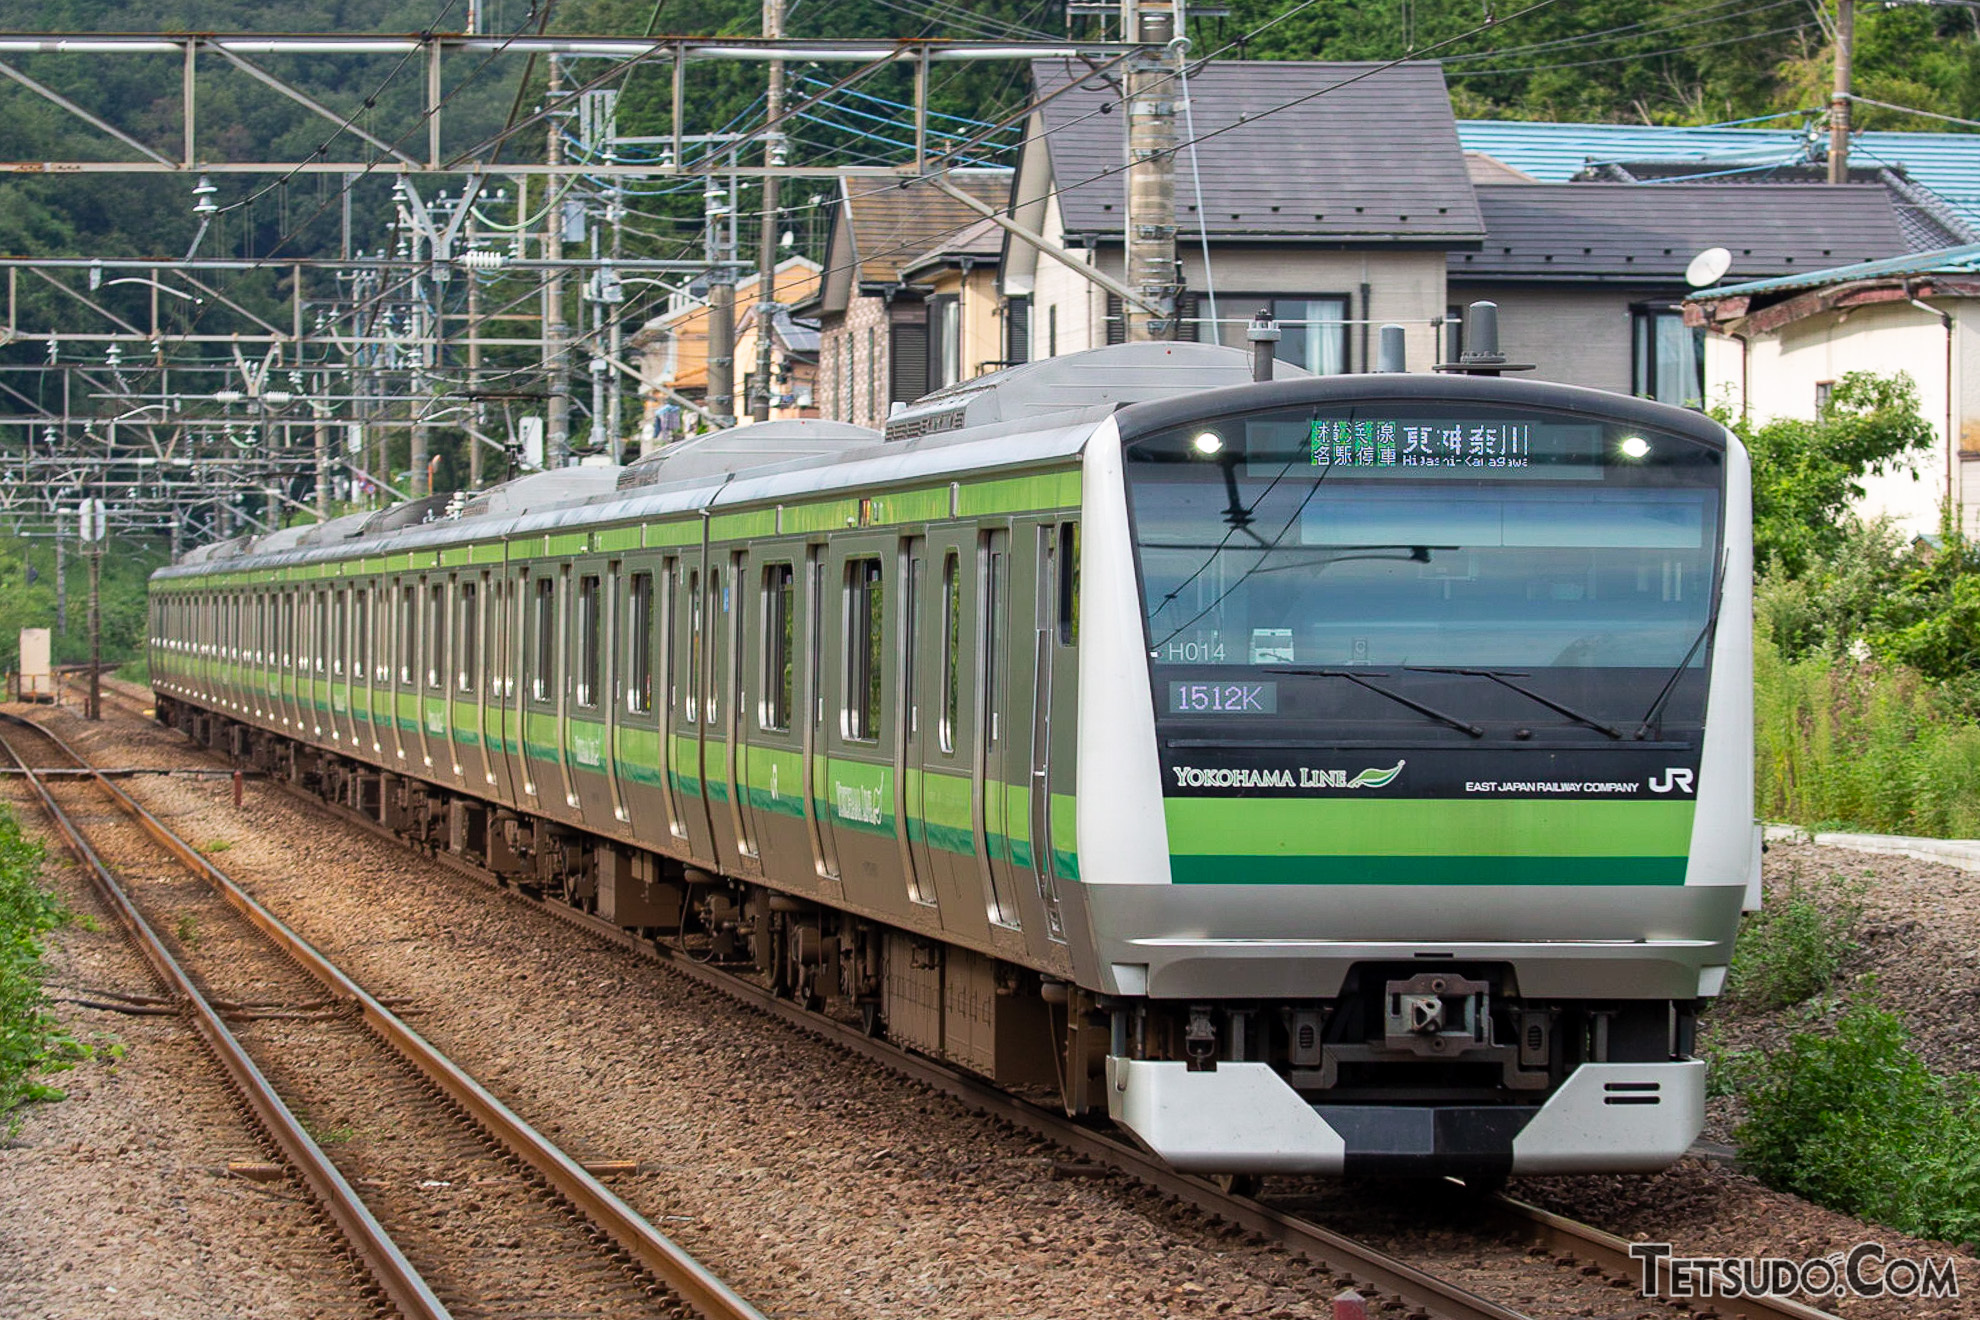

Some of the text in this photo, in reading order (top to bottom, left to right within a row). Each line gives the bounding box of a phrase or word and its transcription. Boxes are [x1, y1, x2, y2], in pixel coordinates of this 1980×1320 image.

[1402, 424, 1528, 456] 東神奈川
[1313, 445, 1397, 467] 各駅停車
[1168, 642, 1226, 661] H014
[1178, 685, 1263, 711] 1512K
[1173, 766, 1348, 788] YOKOHAMA LINE
[1465, 781, 1640, 793] EAST JAPAN RAILWAY COMPANY
[1648, 767, 1694, 793] JR
